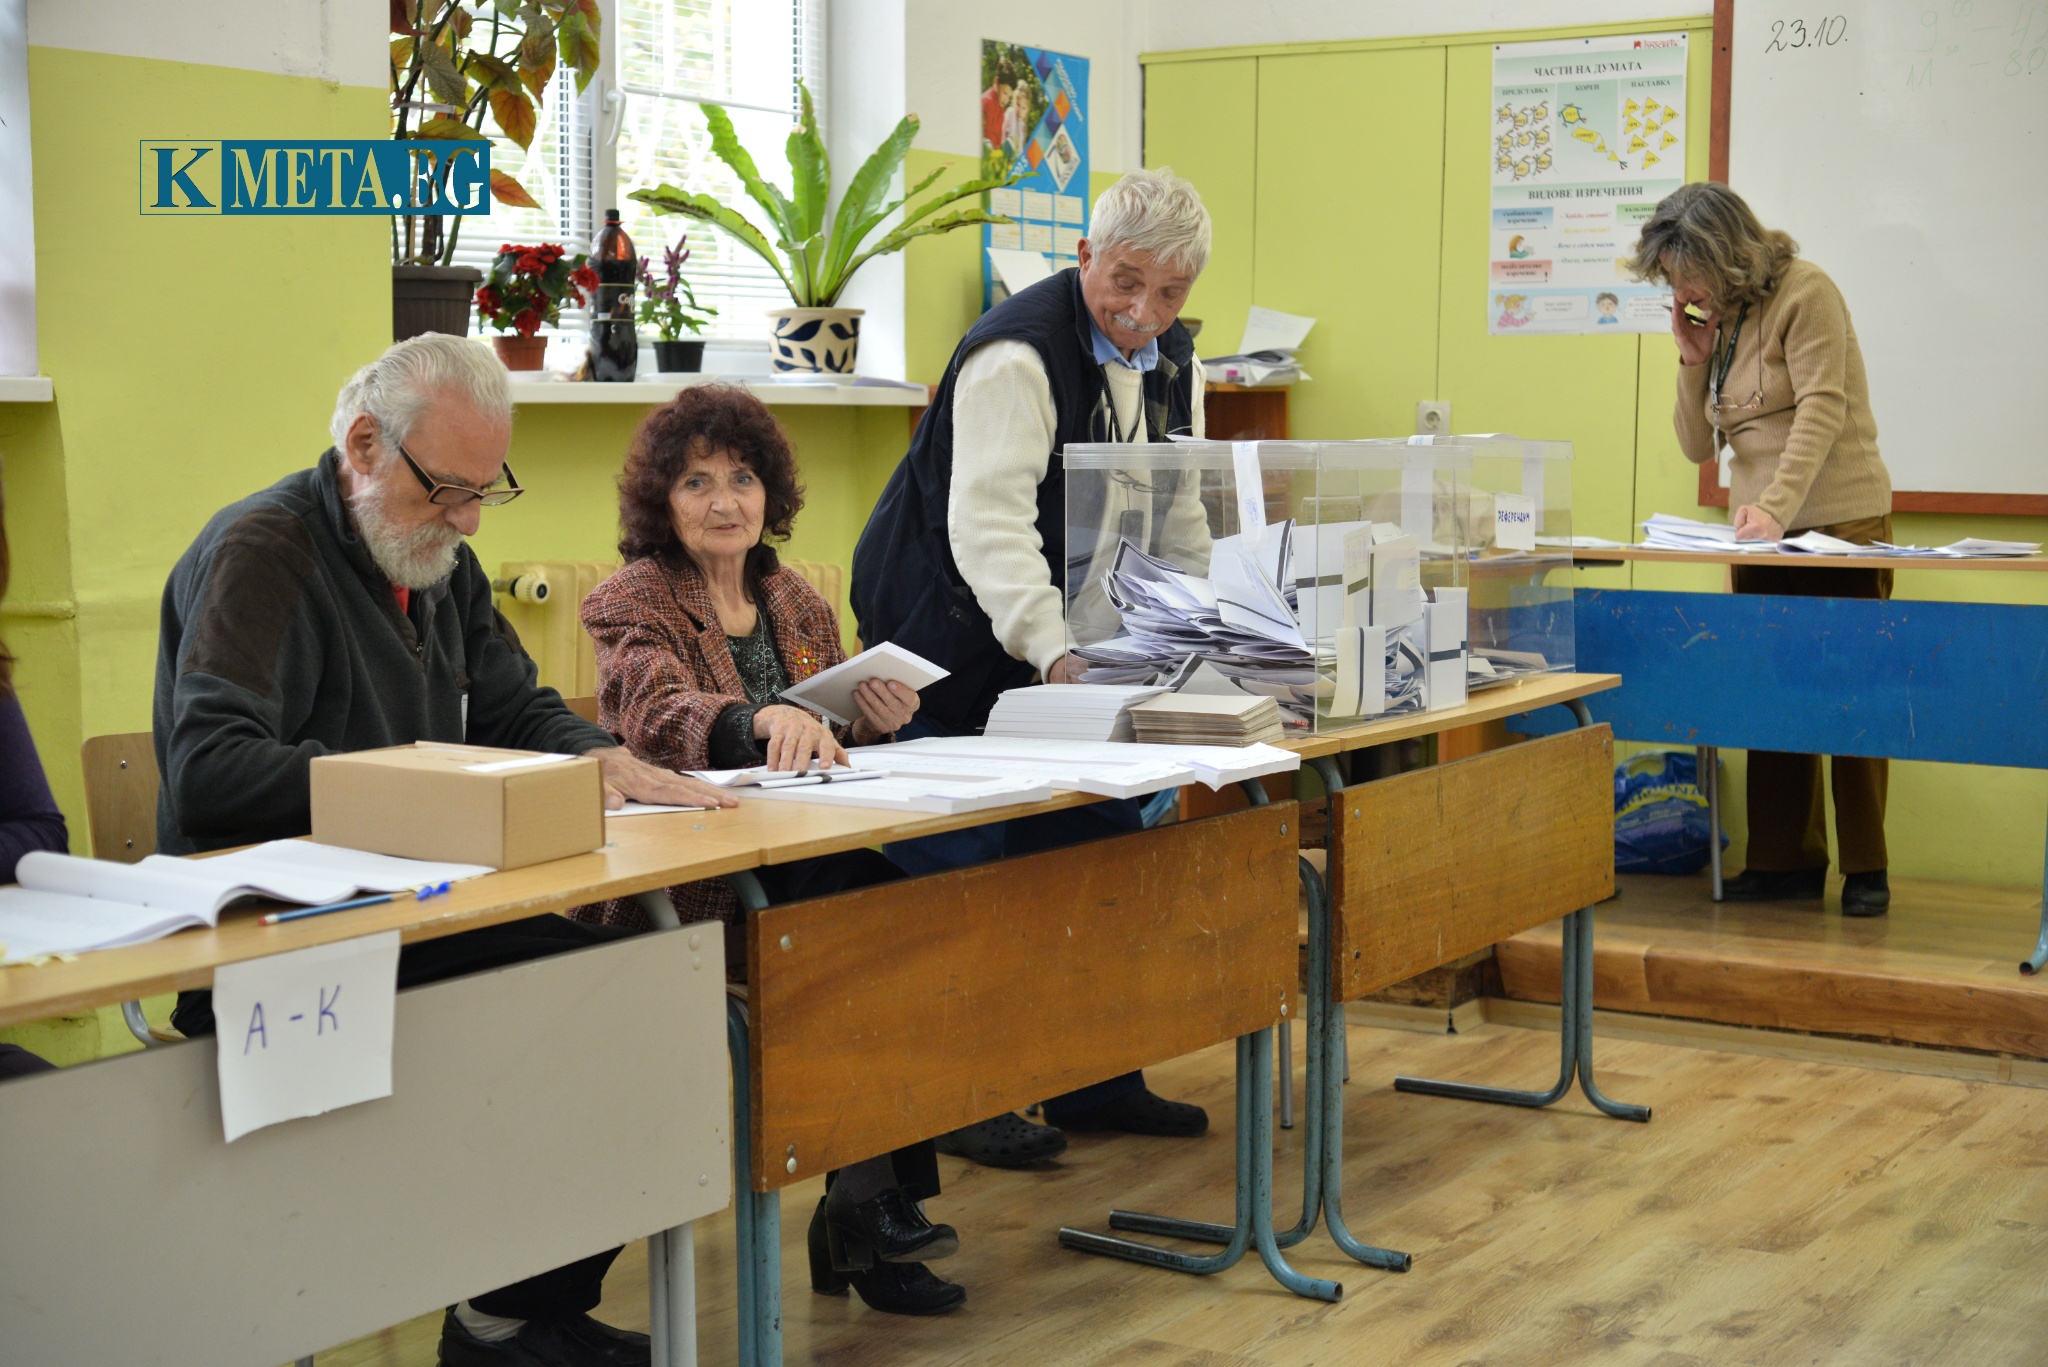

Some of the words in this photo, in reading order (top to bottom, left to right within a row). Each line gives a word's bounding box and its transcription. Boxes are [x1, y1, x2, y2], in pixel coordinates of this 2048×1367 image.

[1764, 15, 1848, 54] 23.10.
[1534, 64, 1573, 77] ЧАСТИ
[1576, 64, 1591, 75] НА
[1593, 61, 1643, 74] ДУМАТА
[1575, 83, 1600, 92] КОРЕН
[1631, 79, 1671, 88] НАСТАВКА
[1502, 87, 1549, 96] ПРЕДСТАВКА
[1528, 188, 1572, 200] ВИДОВЕ
[1576, 186, 1643, 198] ИЗРЕЧЕНИЯ
[1498, 510, 1530, 523] РЕФЕРЕНДУМ
